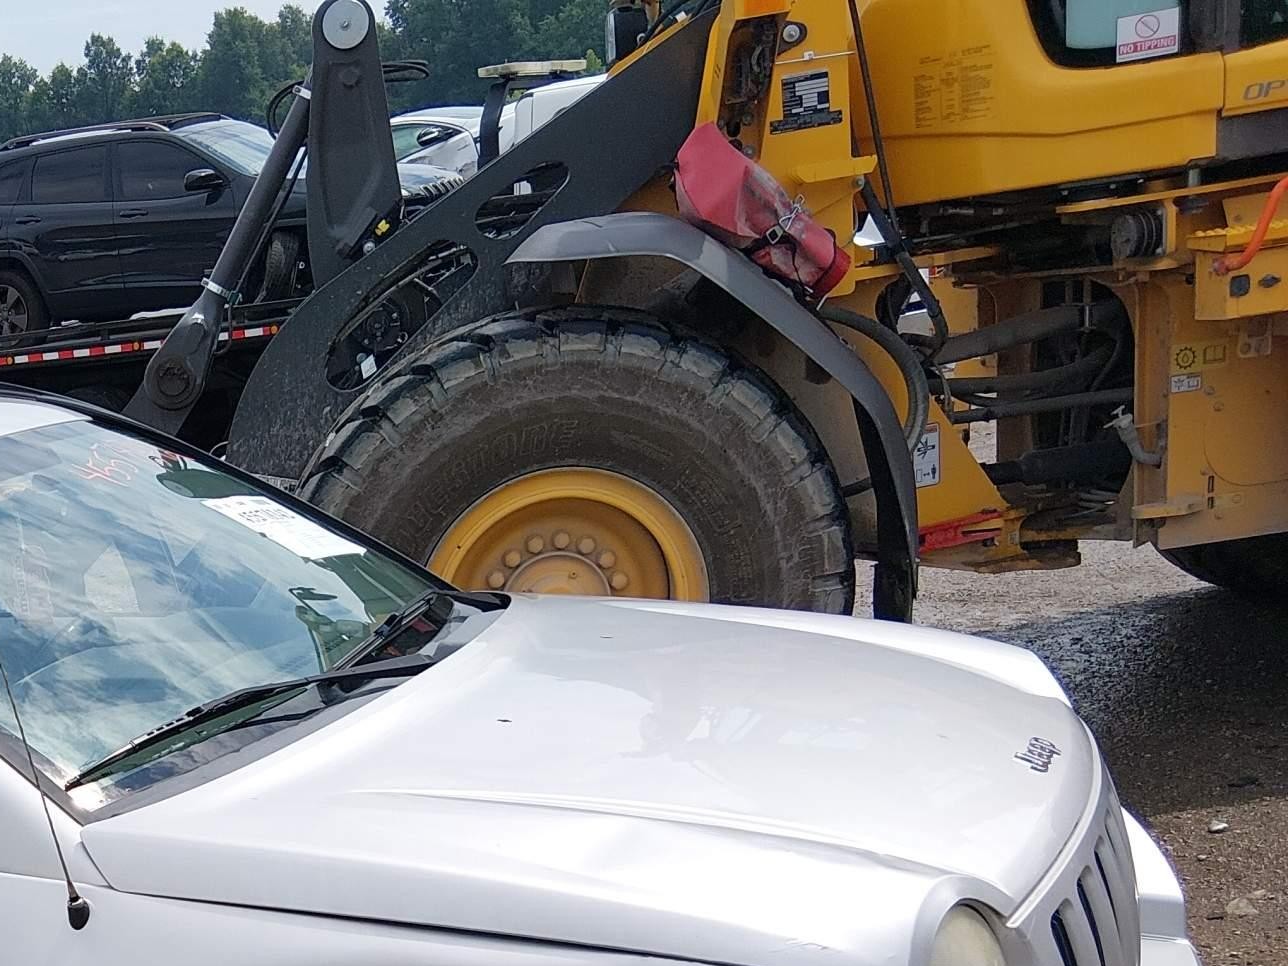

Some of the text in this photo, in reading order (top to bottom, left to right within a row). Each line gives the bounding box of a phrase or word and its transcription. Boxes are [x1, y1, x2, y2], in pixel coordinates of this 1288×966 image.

[1120, 44, 1134, 55] NO
[1136, 36, 1175, 51] TIPPING
[1242, 77, 1288, 102] OP
[1014, 736, 1062, 772] Jeep
